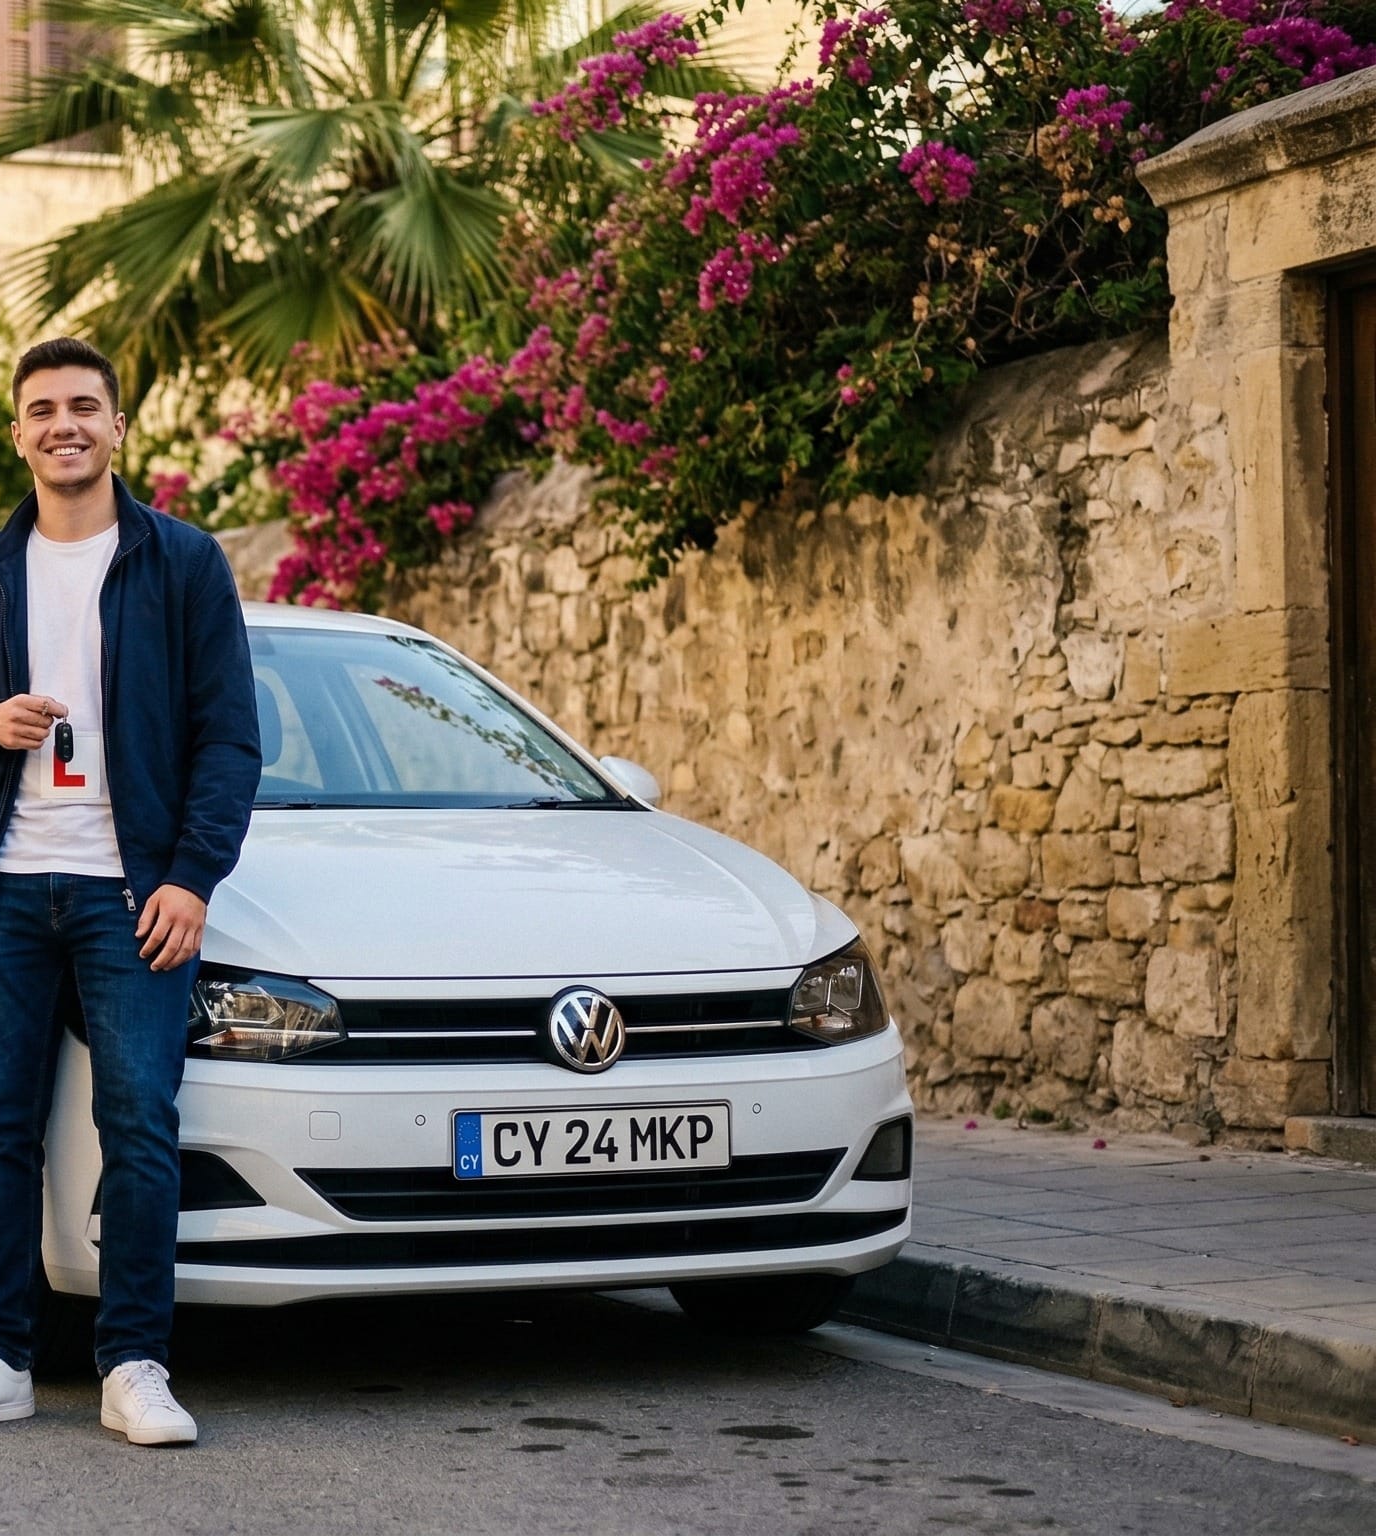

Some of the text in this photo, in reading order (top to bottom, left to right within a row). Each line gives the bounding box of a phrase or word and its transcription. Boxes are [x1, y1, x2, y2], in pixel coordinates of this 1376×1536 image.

[52, 745, 85, 787] L
[554, 993, 622, 1065] VW
[460, 1155, 479, 1170] CY
[493, 1114, 714, 1167] CY 24 MKP
